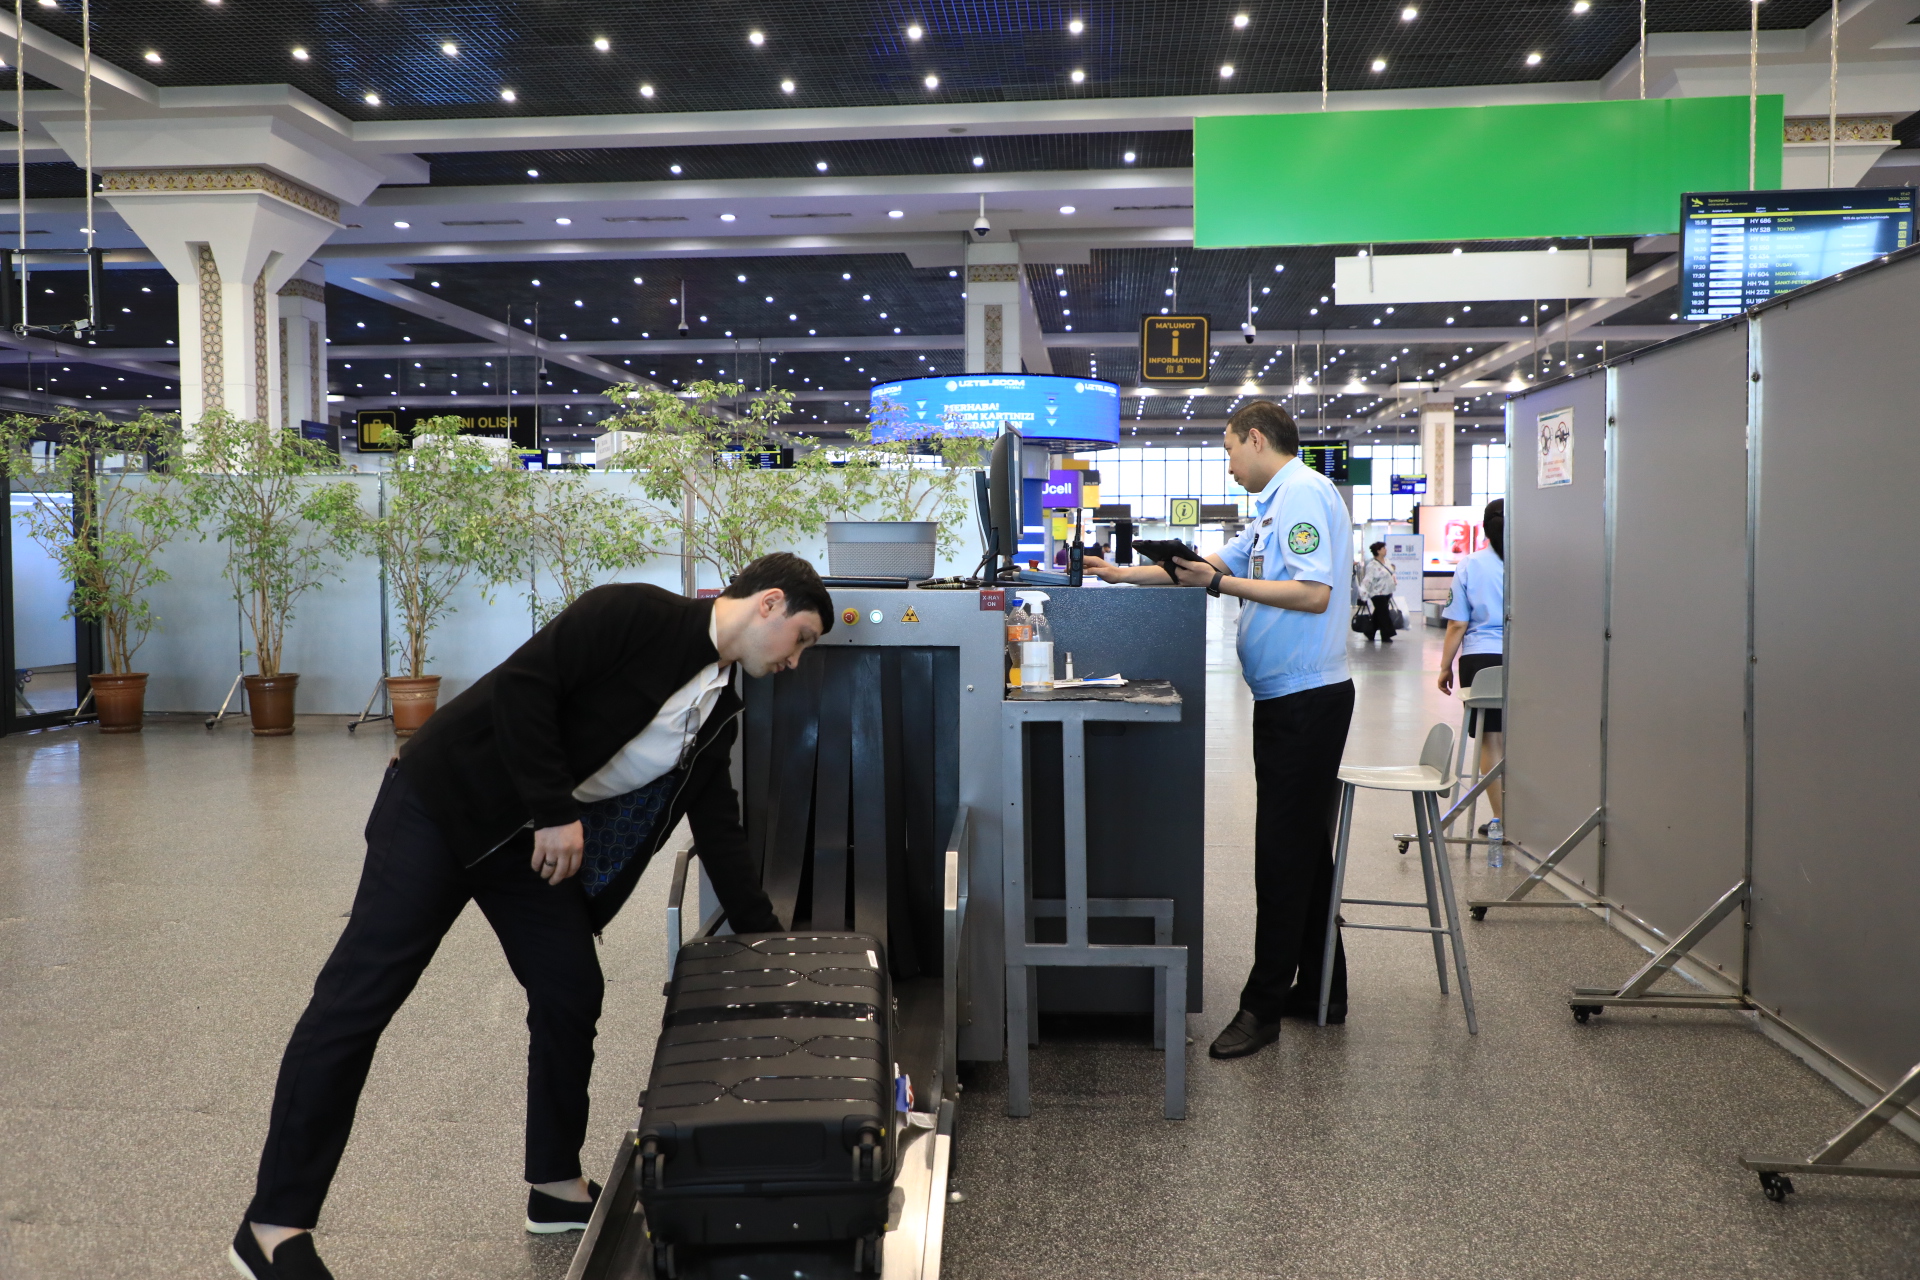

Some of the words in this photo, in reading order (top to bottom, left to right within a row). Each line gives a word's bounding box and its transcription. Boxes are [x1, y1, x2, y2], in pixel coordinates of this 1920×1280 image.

[959, 380, 1025, 388] UZTELECOM
[980, 412, 1035, 421] KARTINIZI
[478, 417, 518, 429] OLISH
